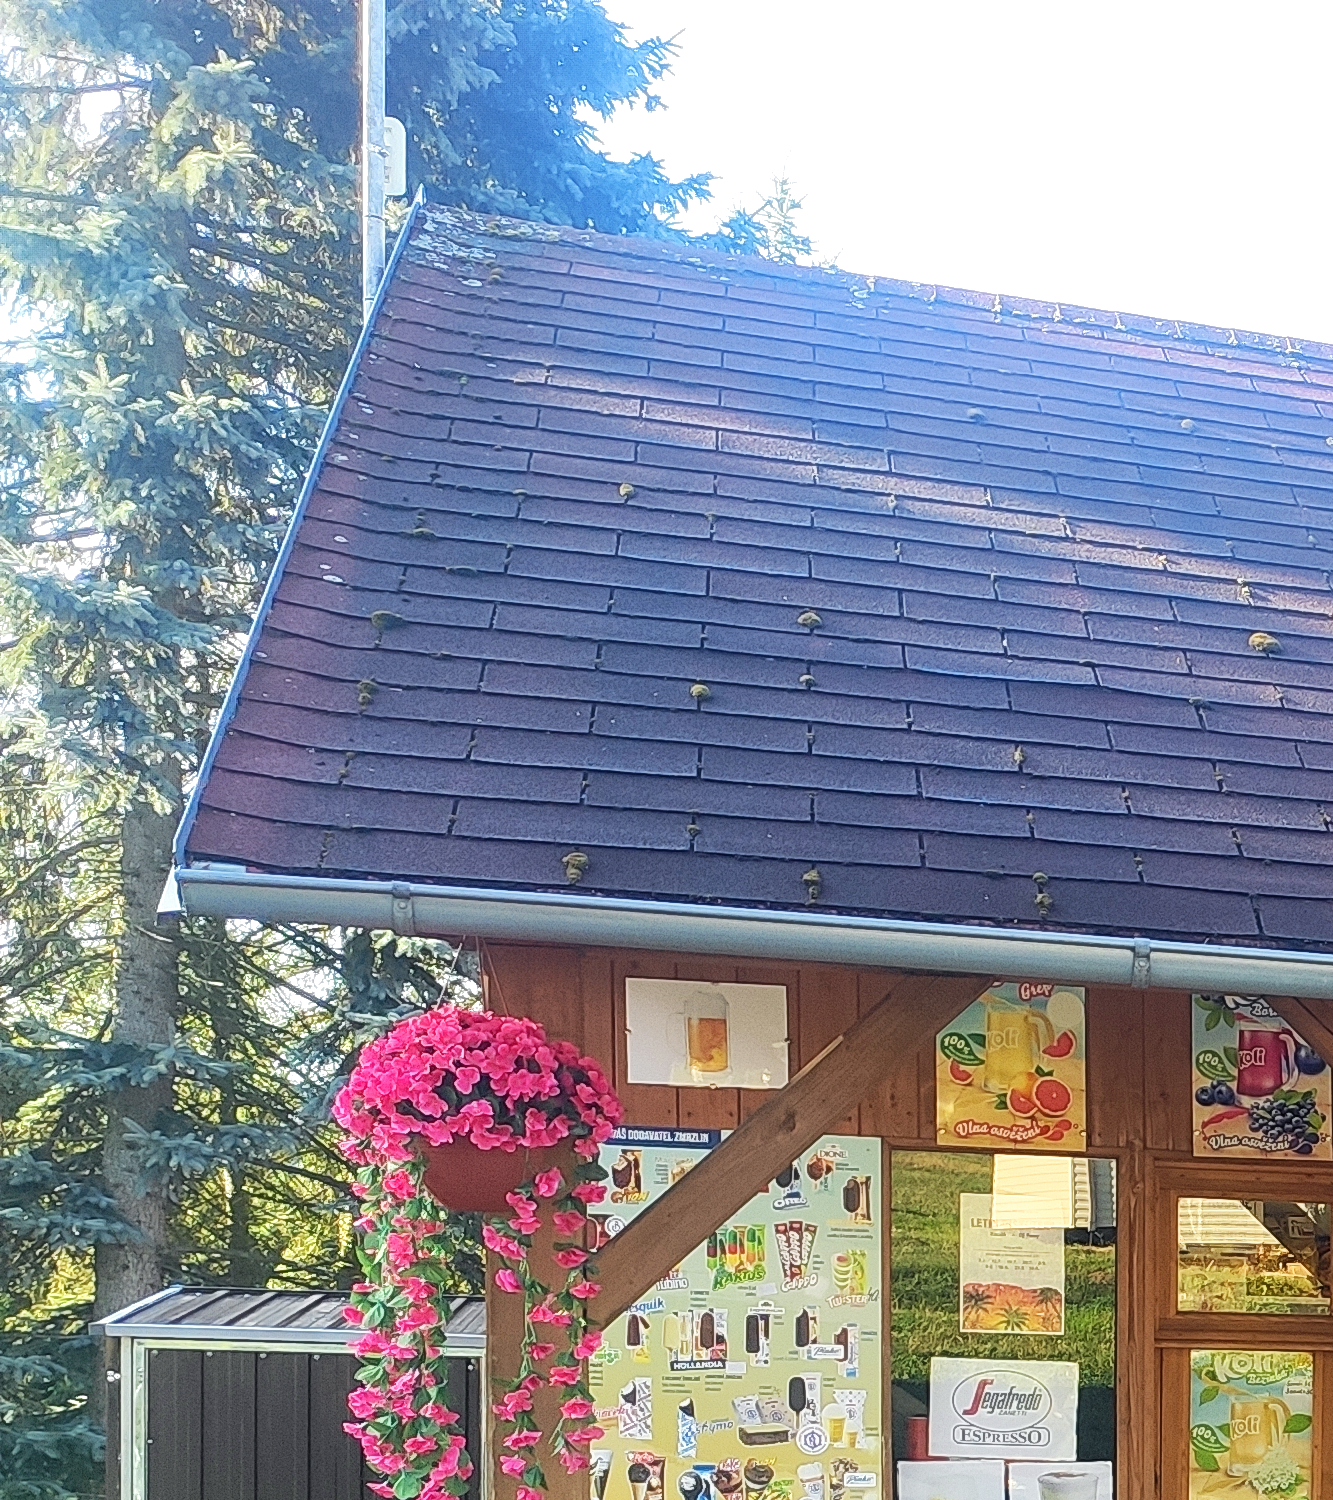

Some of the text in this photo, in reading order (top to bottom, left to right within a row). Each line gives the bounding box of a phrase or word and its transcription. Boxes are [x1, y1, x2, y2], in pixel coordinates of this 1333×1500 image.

[672, 1361, 725, 1371] HOLLANDIA
[962, 1378, 1043, 1416] Segafredo
[959, 1428, 1043, 1445] ESPRESSO
